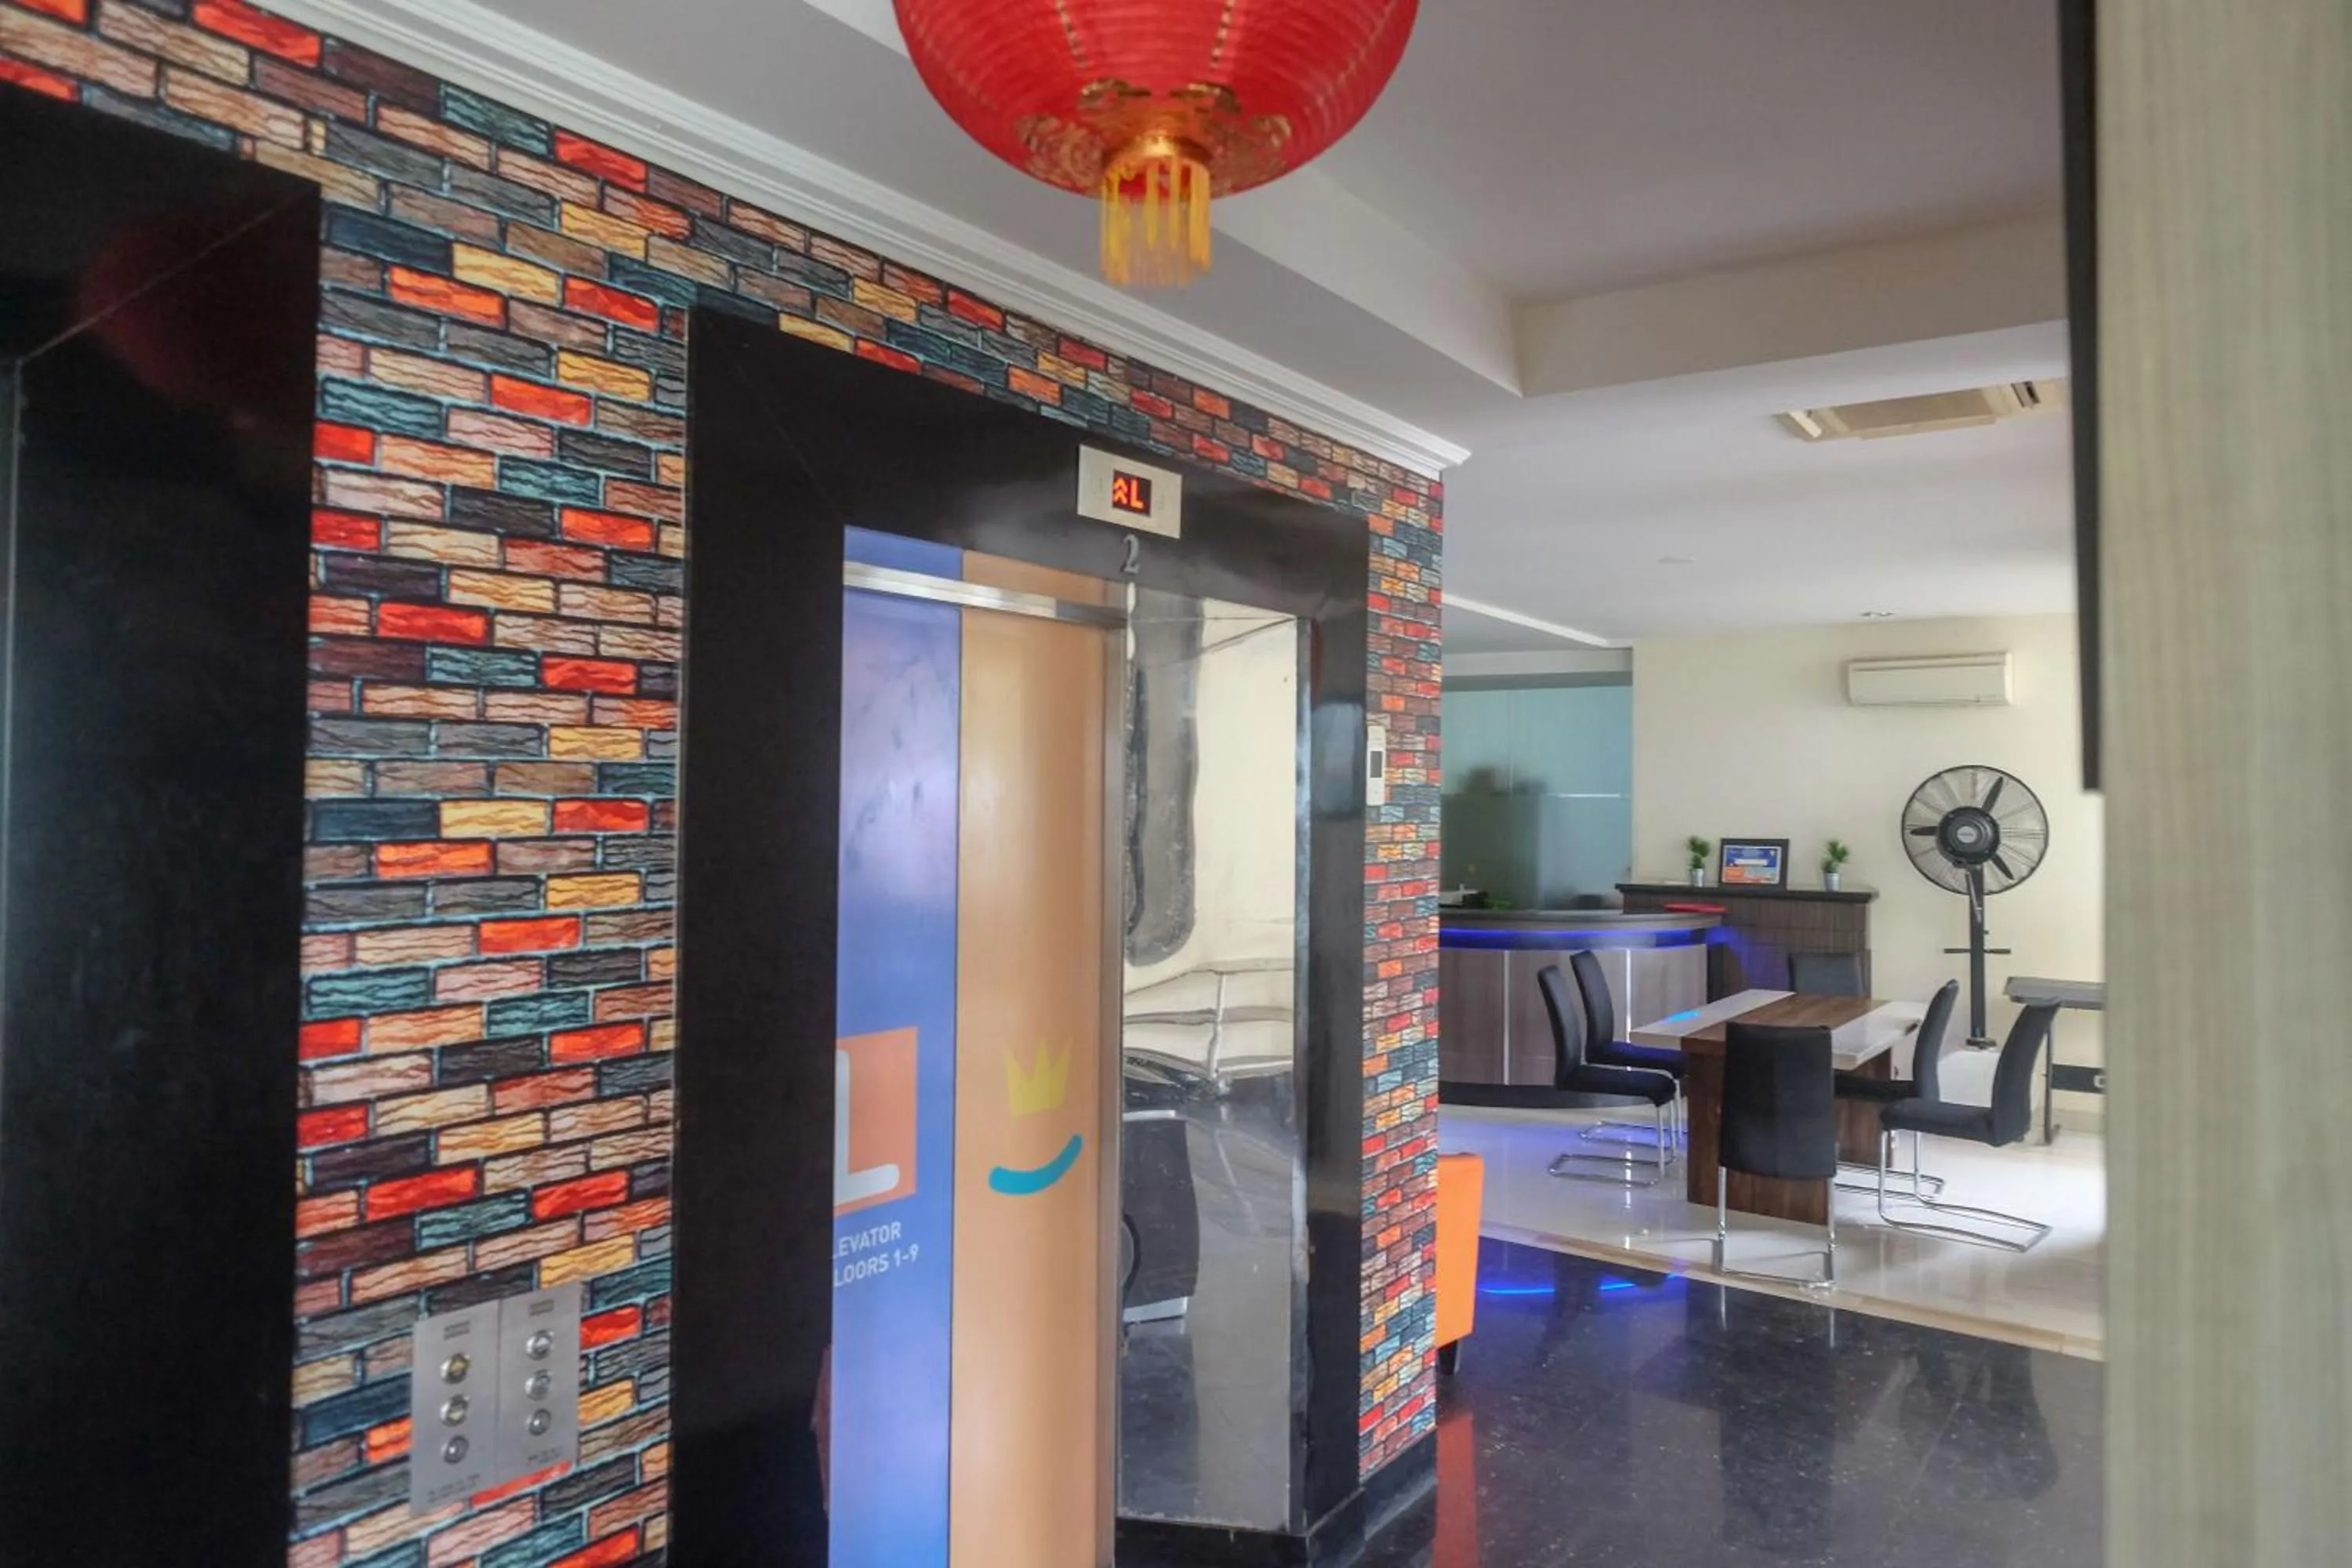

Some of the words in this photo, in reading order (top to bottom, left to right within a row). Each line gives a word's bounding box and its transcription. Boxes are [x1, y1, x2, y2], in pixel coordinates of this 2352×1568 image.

[1130, 479, 1144, 509] L
[1123, 534, 1140, 574] 2
[834, 1221, 902, 1258] EVATOR
[833, 1253, 889, 1287] LOORS
[894, 1243, 920, 1268] 1-9
